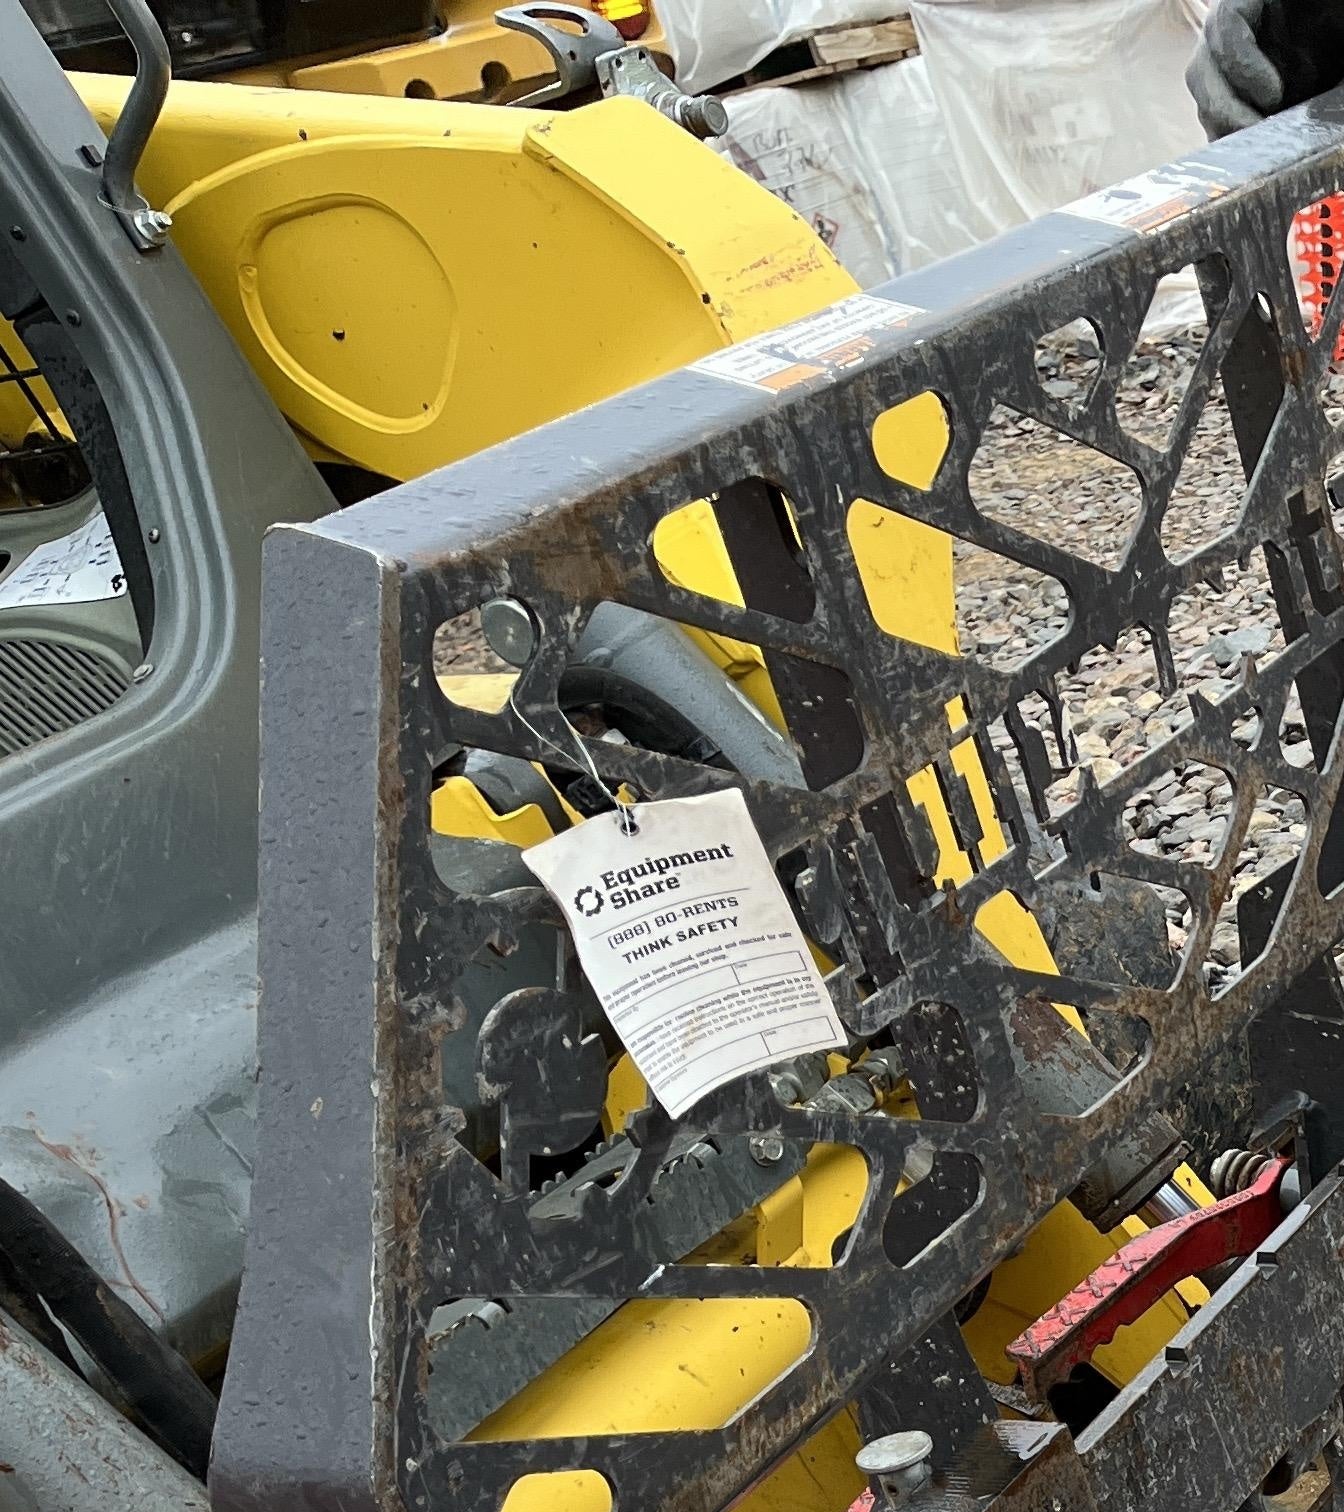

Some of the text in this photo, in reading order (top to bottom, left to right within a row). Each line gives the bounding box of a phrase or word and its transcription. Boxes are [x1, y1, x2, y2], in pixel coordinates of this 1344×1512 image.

[600, 843, 734, 892] Equipment
[609, 875, 681, 910] Share
[607, 896, 739, 949] (888) 80-RENTS
[622, 916, 738, 964] THINK SAFETY
